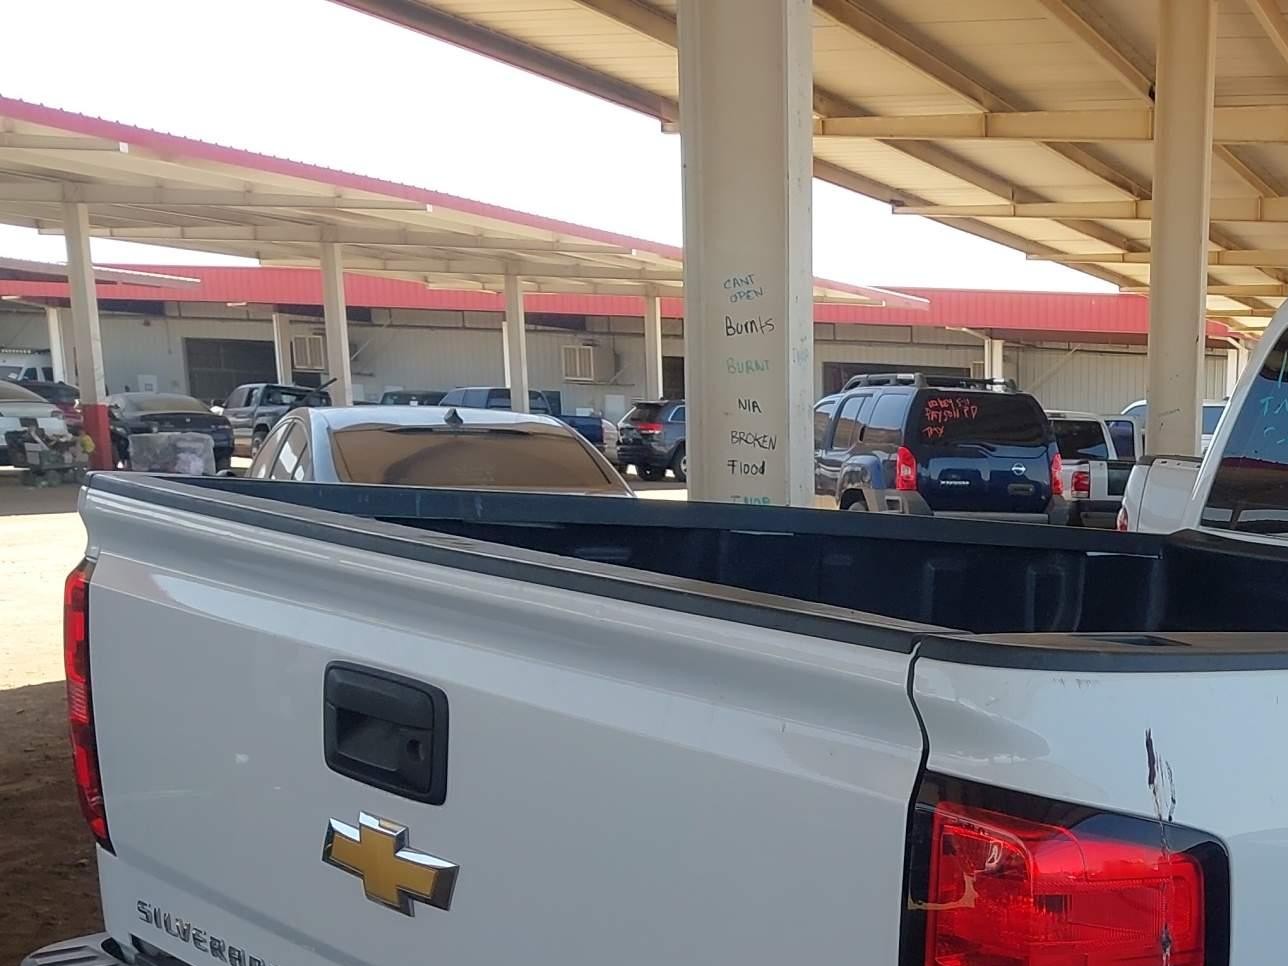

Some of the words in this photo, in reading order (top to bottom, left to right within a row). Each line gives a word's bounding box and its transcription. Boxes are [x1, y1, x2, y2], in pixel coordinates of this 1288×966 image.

[723, 274, 755, 289] CANT
[729, 287, 763, 303] OPEN
[726, 356, 770, 375] BURNT
[730, 430, 777, 450] BROKEN
